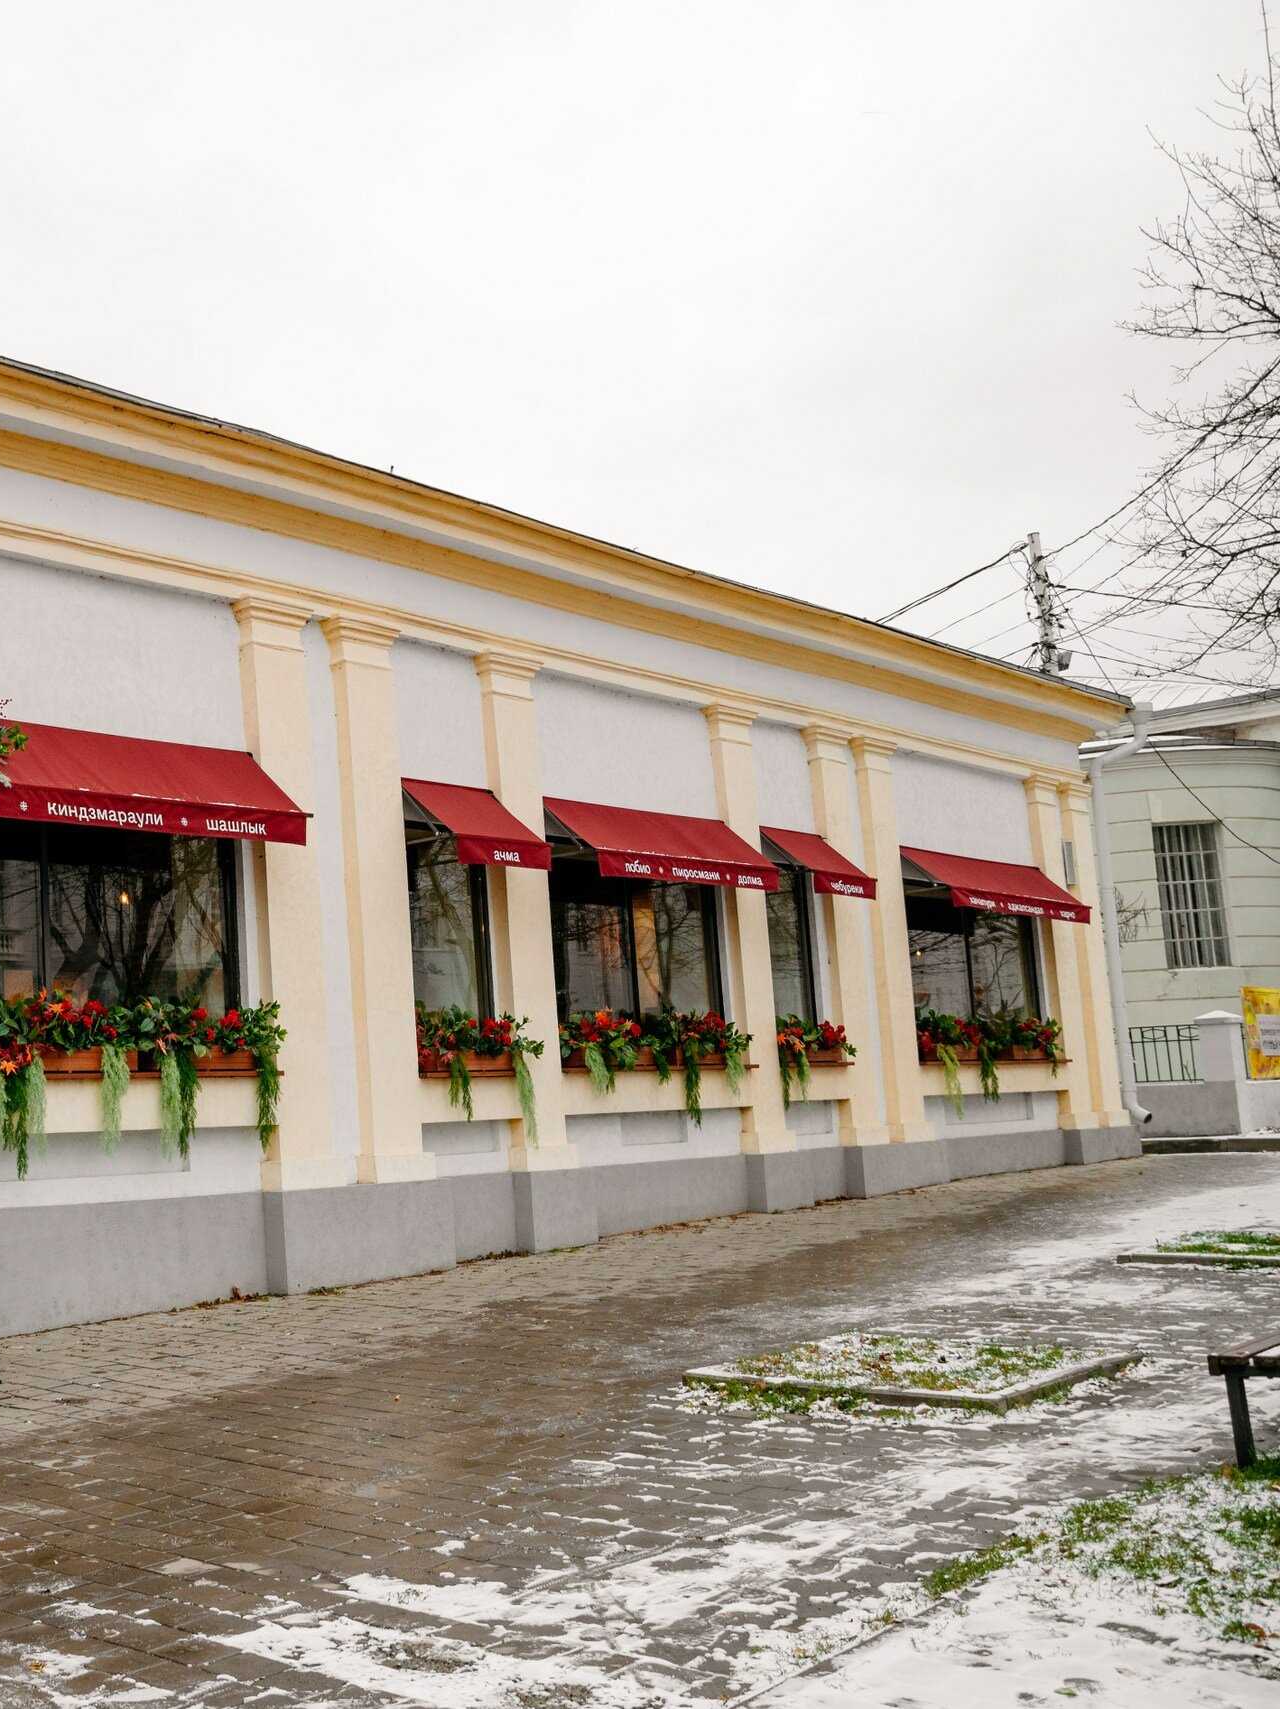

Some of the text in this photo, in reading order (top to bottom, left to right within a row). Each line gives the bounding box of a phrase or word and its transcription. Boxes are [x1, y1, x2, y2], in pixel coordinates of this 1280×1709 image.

[47, 801, 164, 828] киндзмараули
[205, 818, 267, 836] шашлык
[493, 849, 521, 863] ачма
[624, 860, 764, 887] лобио пиросмани долма
[830, 879, 865, 895] чебуреки
